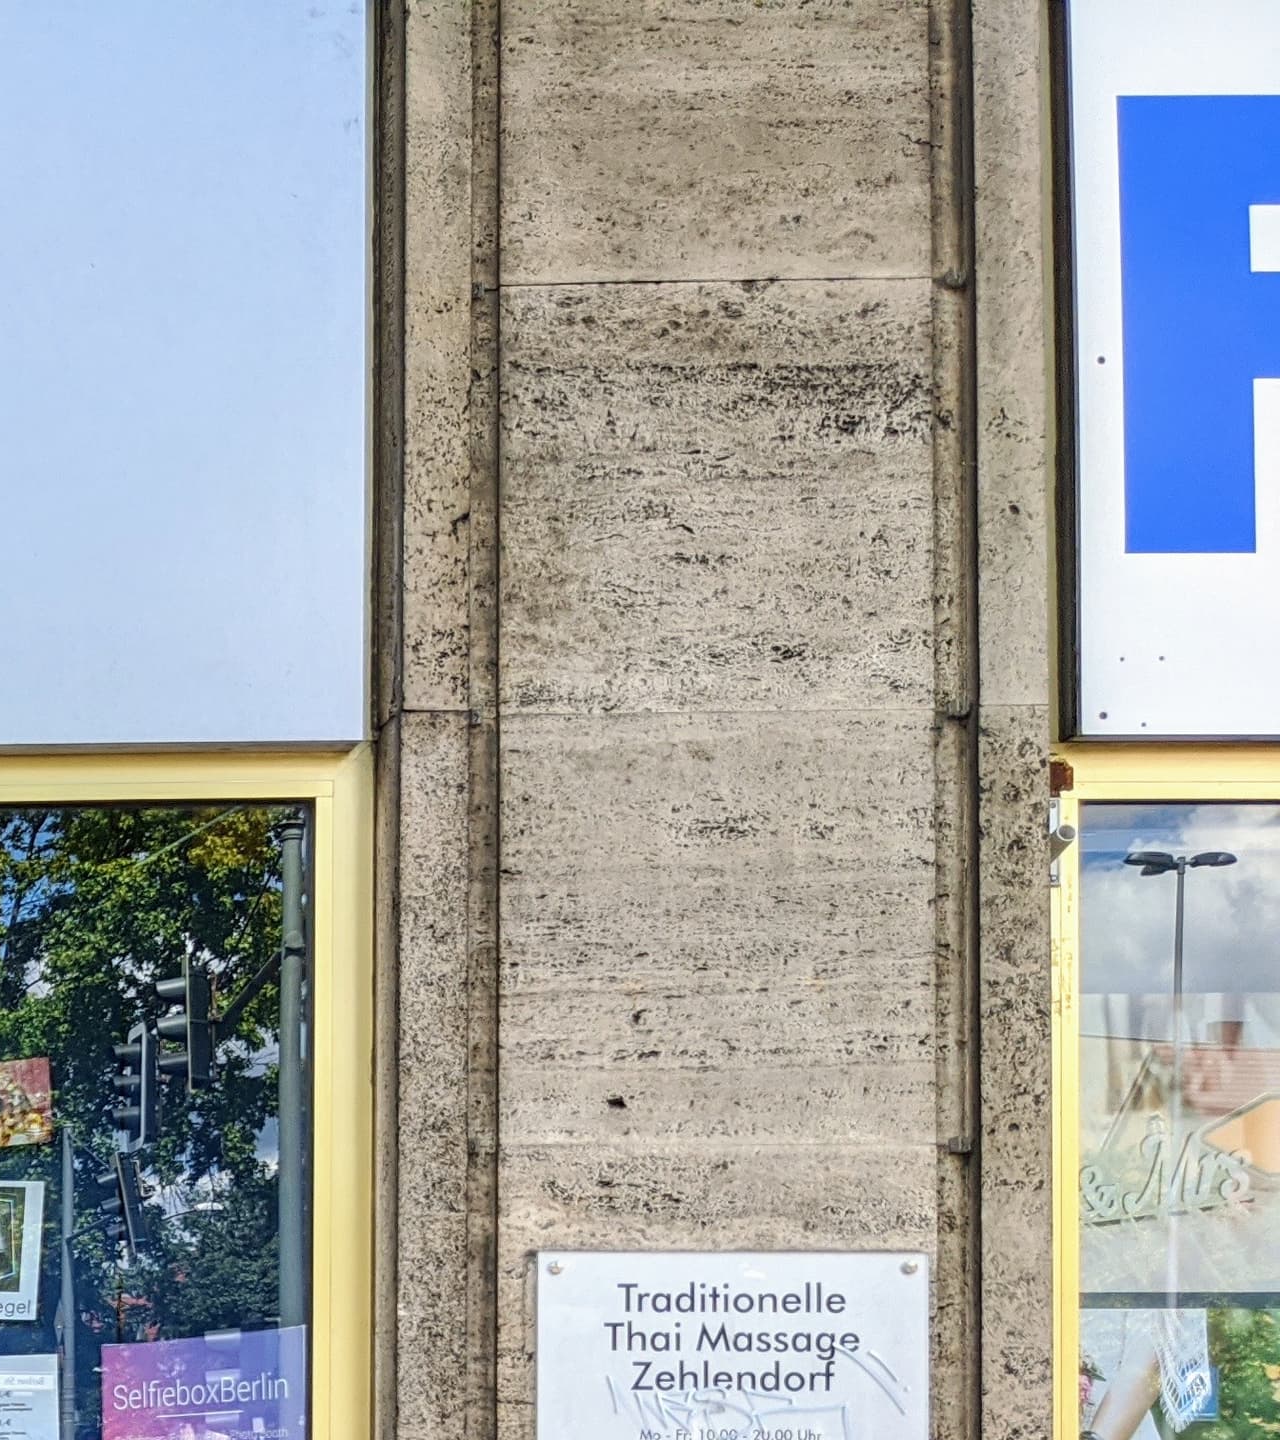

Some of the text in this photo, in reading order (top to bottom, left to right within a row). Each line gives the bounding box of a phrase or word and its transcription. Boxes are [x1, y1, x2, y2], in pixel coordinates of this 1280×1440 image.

[617, 1282, 847, 1314] Traditionelle
[604, 1321, 860, 1360] Thai Massage
[113, 1372, 288, 1410] SelfieboxBerlin
[631, 1360, 836, 1392] Zehlendorf
[640, 1429, 661, 1440] Mo
[699, 1429, 738, 1440] 10.00
[753, 1429, 793, 1440] 20.00
[797, 1428, 822, 1440] Uhr
